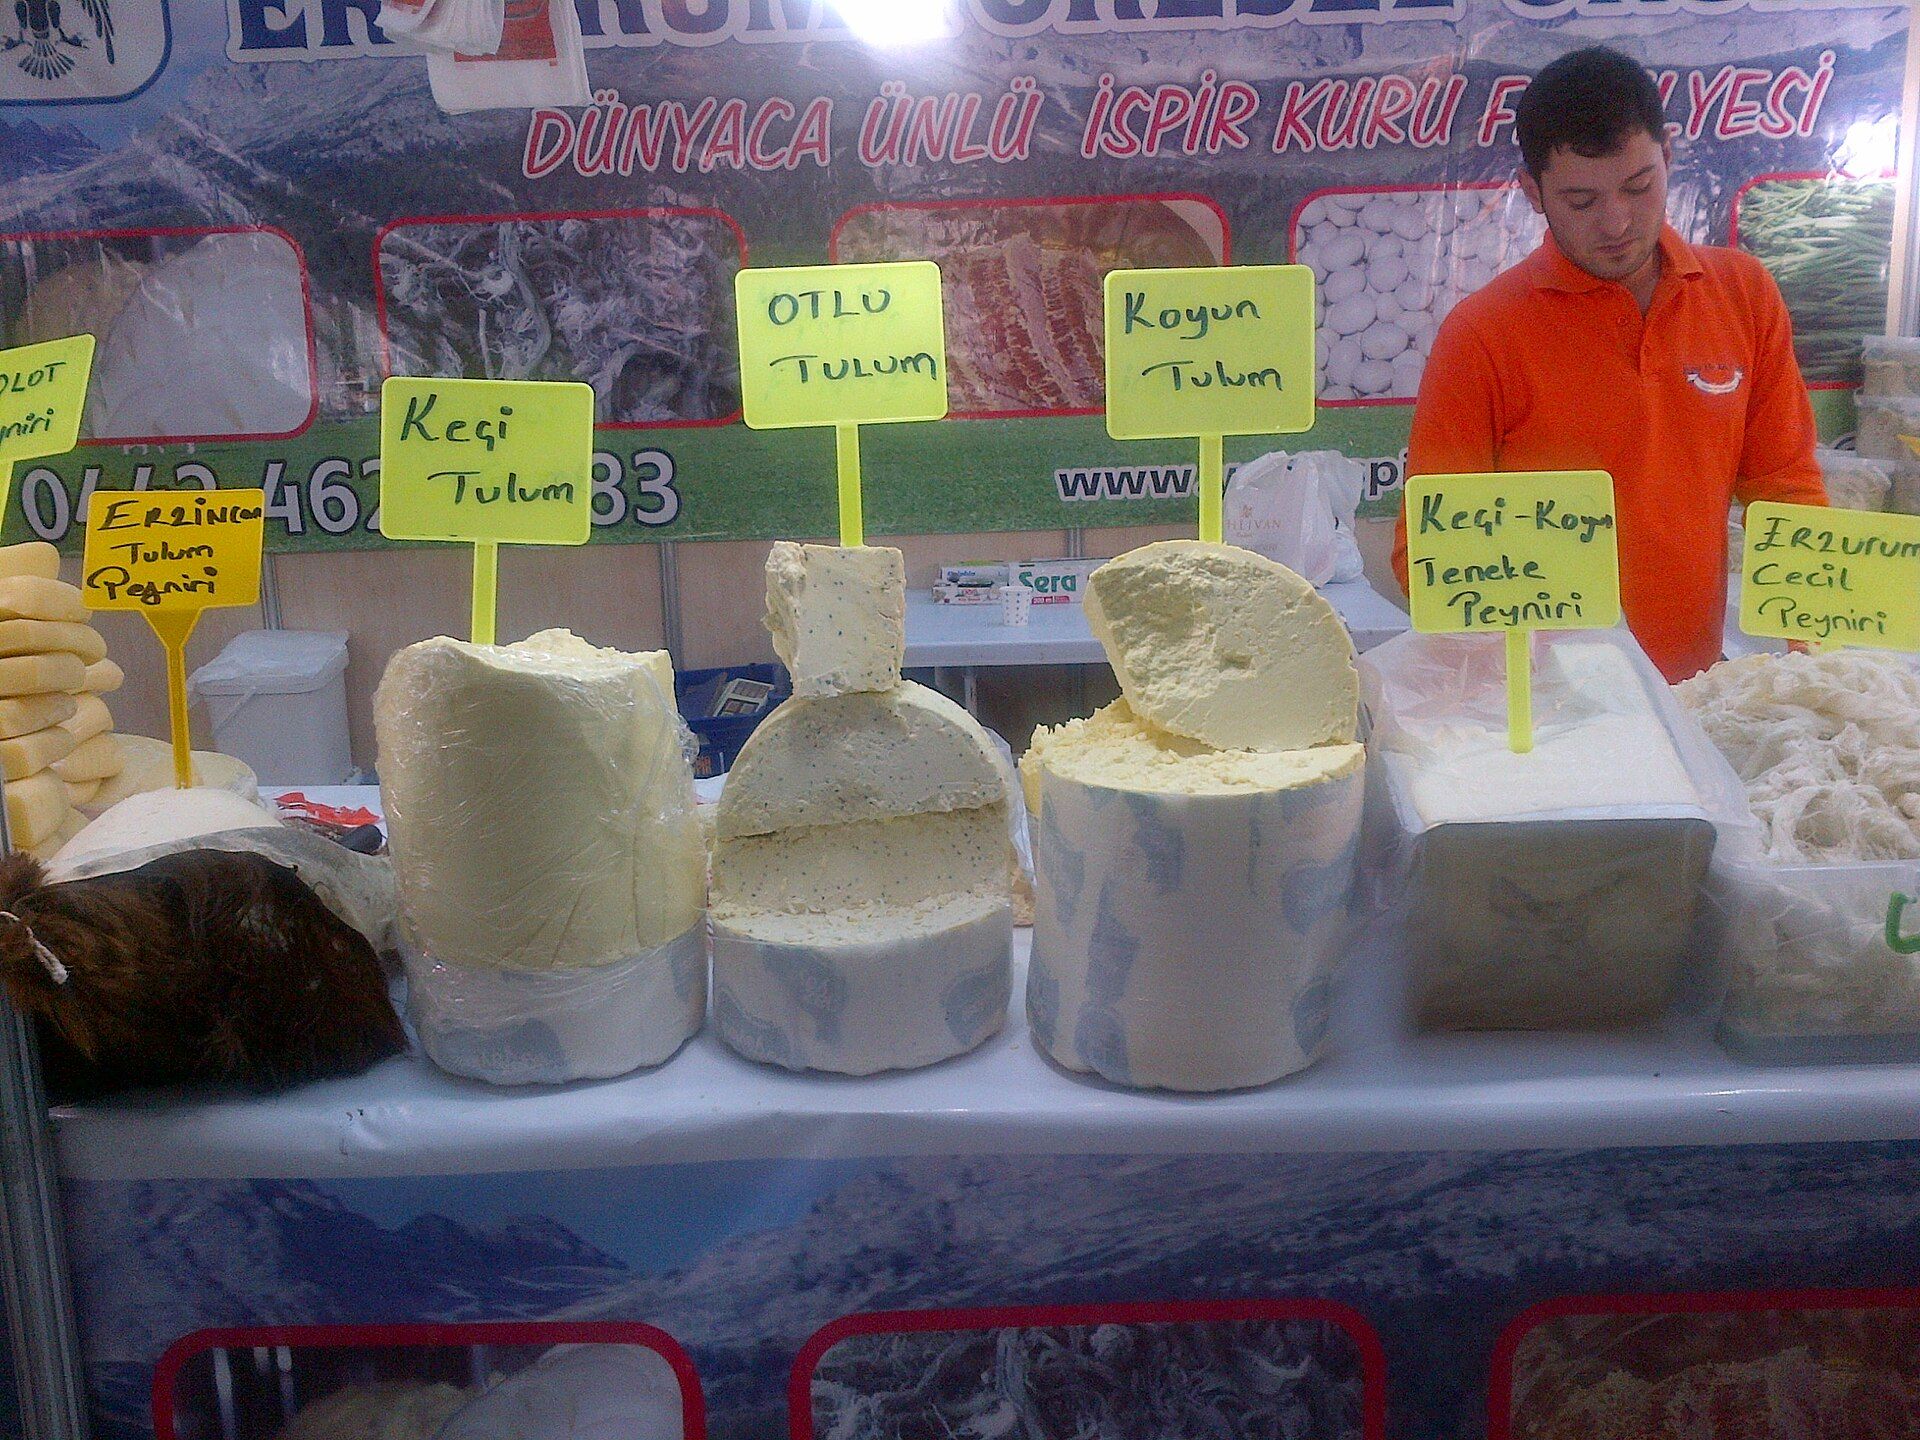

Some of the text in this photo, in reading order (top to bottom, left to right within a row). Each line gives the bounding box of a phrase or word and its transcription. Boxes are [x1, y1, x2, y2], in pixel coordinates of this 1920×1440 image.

[523, 90, 832, 177] DÜNYACA
[857, 75, 1043, 170] ÜNLÜ
[1080, 68, 1260, 161] İSPİR
[1271, 74, 1465, 152] KURU
[768, 289, 892, 326] OTLU
[1125, 293, 1261, 340] Koyun
[1142, 360, 1284, 391] Tulum
[400, 393, 514, 451] Keçi
[427, 470, 575, 504] Tulum
[110, 541, 214, 564] Tulum
[1018, 571, 1077, 593] Sera
[1414, 555, 1546, 586] Teneke
[1447, 591, 1582, 626] Peyniri
[1758, 597, 1887, 637] Peyniri
